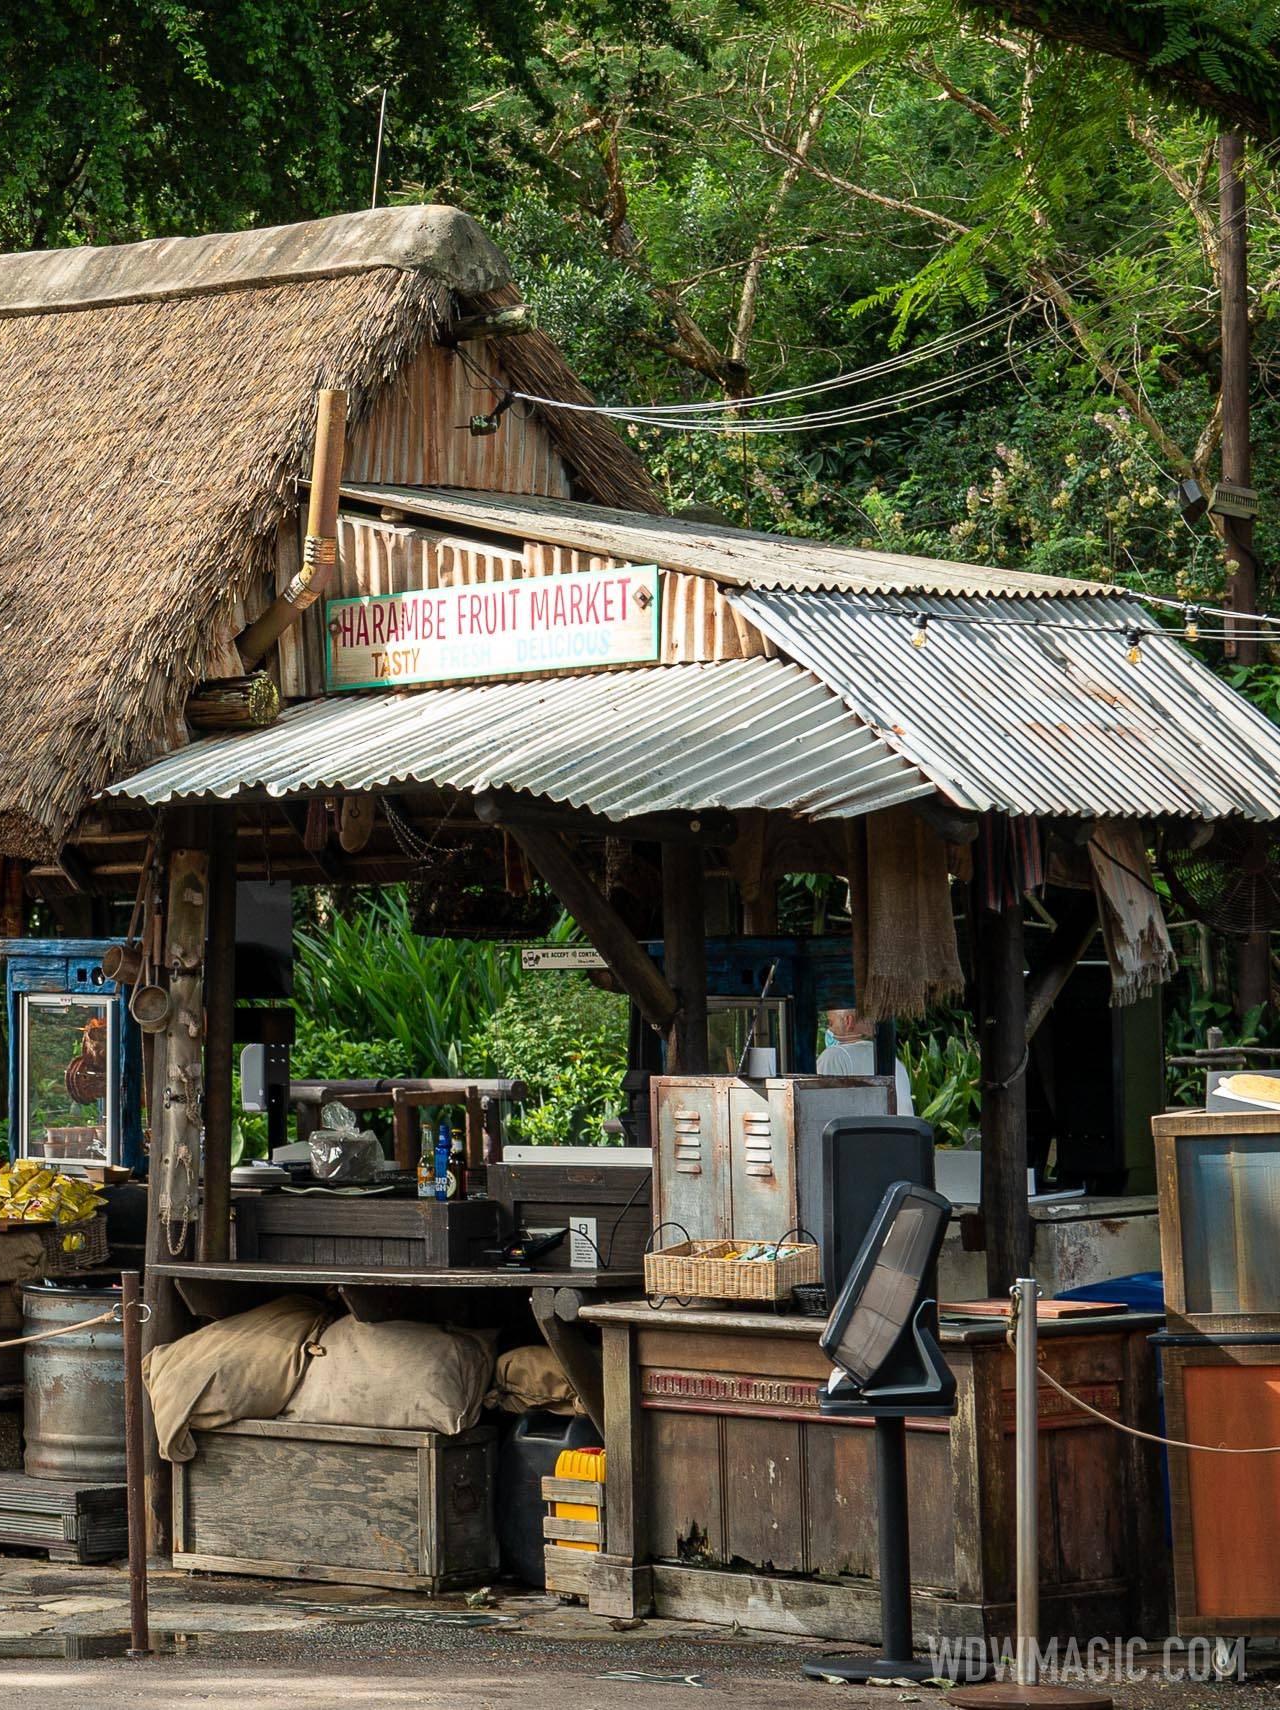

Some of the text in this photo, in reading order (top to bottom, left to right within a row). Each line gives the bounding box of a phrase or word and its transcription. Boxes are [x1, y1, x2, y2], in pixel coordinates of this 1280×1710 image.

[341, 578, 632, 648] HARAMBE FRUIT MARKET
[371, 629, 611, 678] TASTY FRESH DELICIOUS
